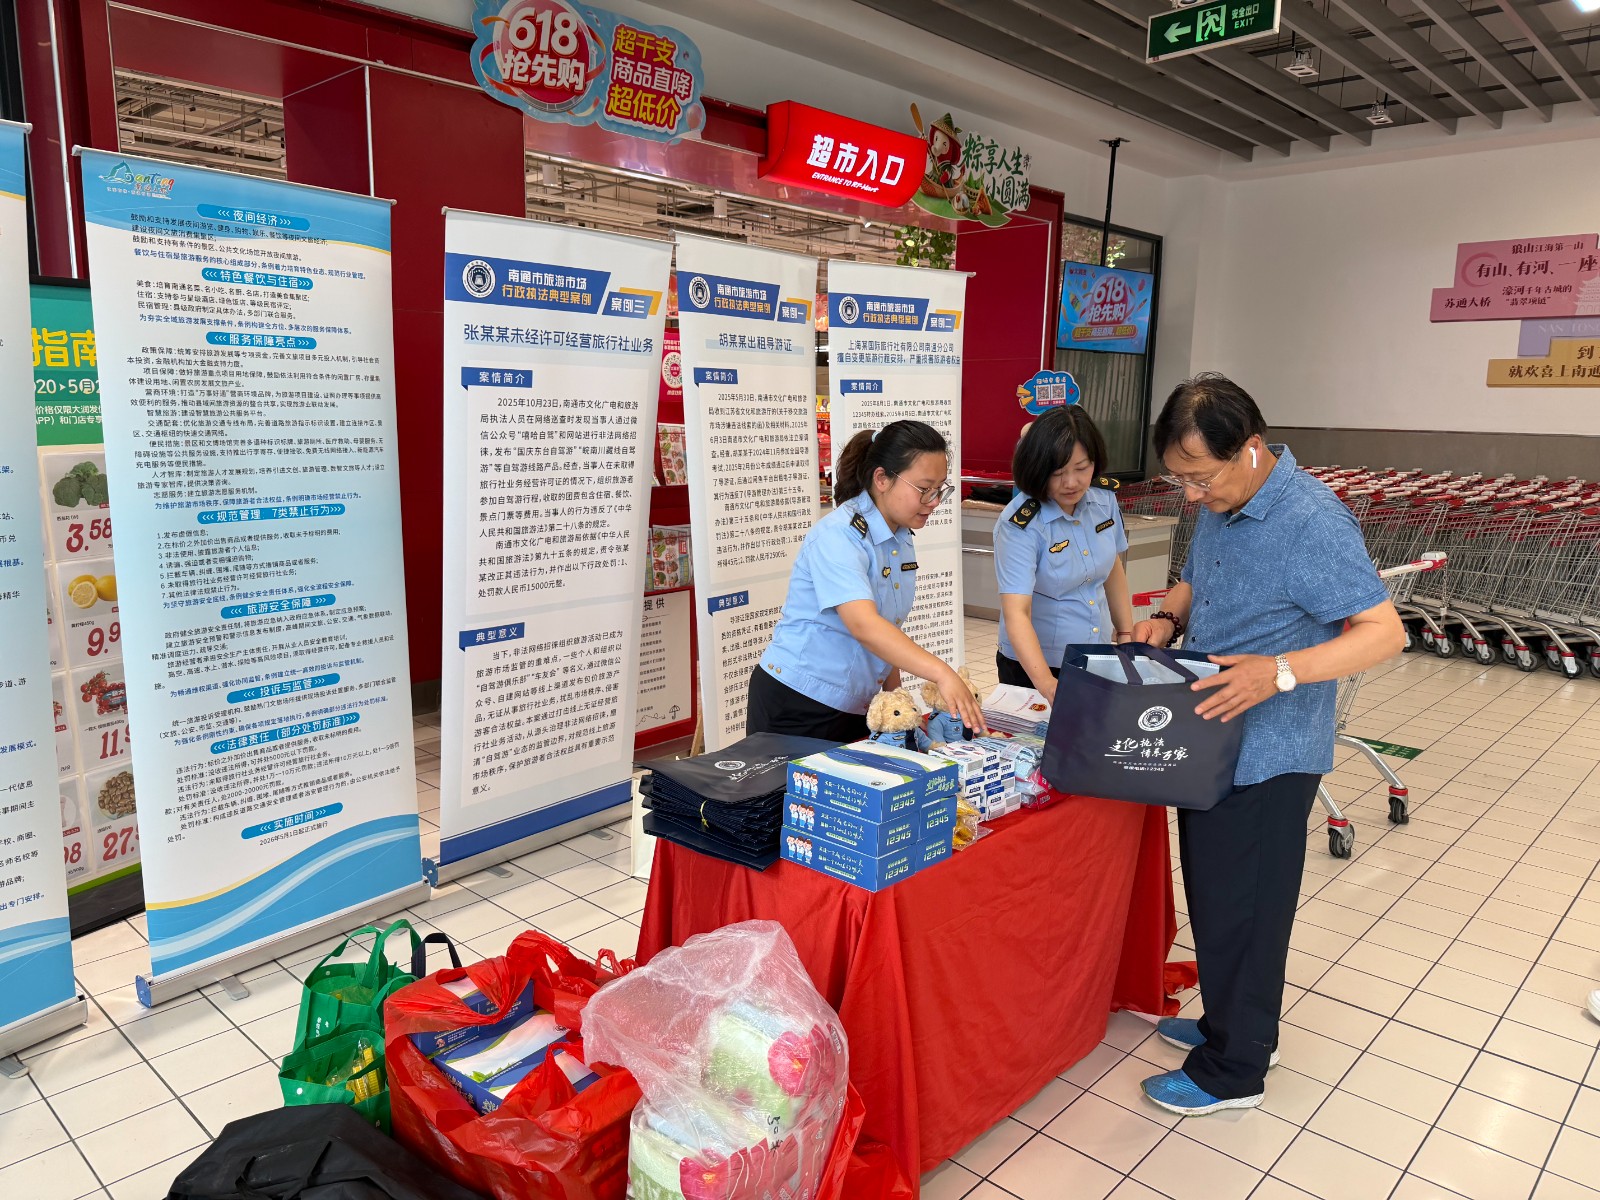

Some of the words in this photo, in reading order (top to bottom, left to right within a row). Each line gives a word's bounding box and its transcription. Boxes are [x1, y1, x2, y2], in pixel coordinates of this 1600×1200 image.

[1232, 3, 1260, 20] 安全出口
[1234, 17, 1255, 29] EXIT
[507, 7, 579, 57] 618
[502, 50, 585, 91] 抢先购
[612, 56, 692, 98] 商品直降
[607, 84, 681, 127] 超低价
[806, 134, 905, 186] 超市入口
[957, 132, 1024, 176] 粽享人生
[811, 171, 844, 185] ENTRANCE
[842, 178, 853, 186] TO
[986, 175, 1030, 211] 小圆满
[233, 209, 278, 227] 夜间经济
[1511, 241, 1584, 254] 狼山江海第一山
[220, 270, 299, 288] 特色餐饮与住宿
[508, 269, 587, 290] 南通市旅游市场
[502, 285, 592, 306] 行政执法典型案例
[717, 283, 767, 301] 南通市旅游市场
[1094, 277, 1126, 304] 618
[1502, 284, 1572, 296] 濠河千年古城的
[611, 297, 645, 314] 案例三
[714, 297, 771, 314] 行政执法典型案例
[866, 301, 914, 314] 南通市旅游市场
[1444, 297, 1492, 309] 苏通大桥
[782, 306, 804, 319] 案例一
[863, 312, 918, 325] 行政执法典型案例
[1088, 303, 1126, 322] 抢先购
[930, 317, 952, 328] 案例二
[229, 333, 296, 348] 服务保障亮点
[463, 323, 654, 353] 张某某未经许可经营旅行社业务
[719, 333, 792, 352] 胡某某出租导游证
[479, 371, 525, 385] 案情简介
[705, 371, 734, 382] 案情简介
[851, 382, 879, 391] 案情简介
[36, 405, 101, 414] 价格仅限大润发
[480, 414, 638, 425] 局执法人员在网络巡查时发现当事人通过微
[480, 475, 634, 490] 旅行社业务经营许可证的情况下,组织旅游者
[247, 597, 312, 615] 旅游安全保障
[718, 594, 745, 608] 典型意义
[475, 626, 518, 643] 典型意义
[260, 678, 312, 697] 投诉与监管
[471, 784, 491, 796] 意义。
[890, 797, 916, 813] 12345
[274, 810, 314, 830] 实施时间
[927, 814, 949, 830] 12345
[886, 830, 912, 846] 12345
[923, 846, 947, 861] 12345
[885, 863, 909, 880] 12345
